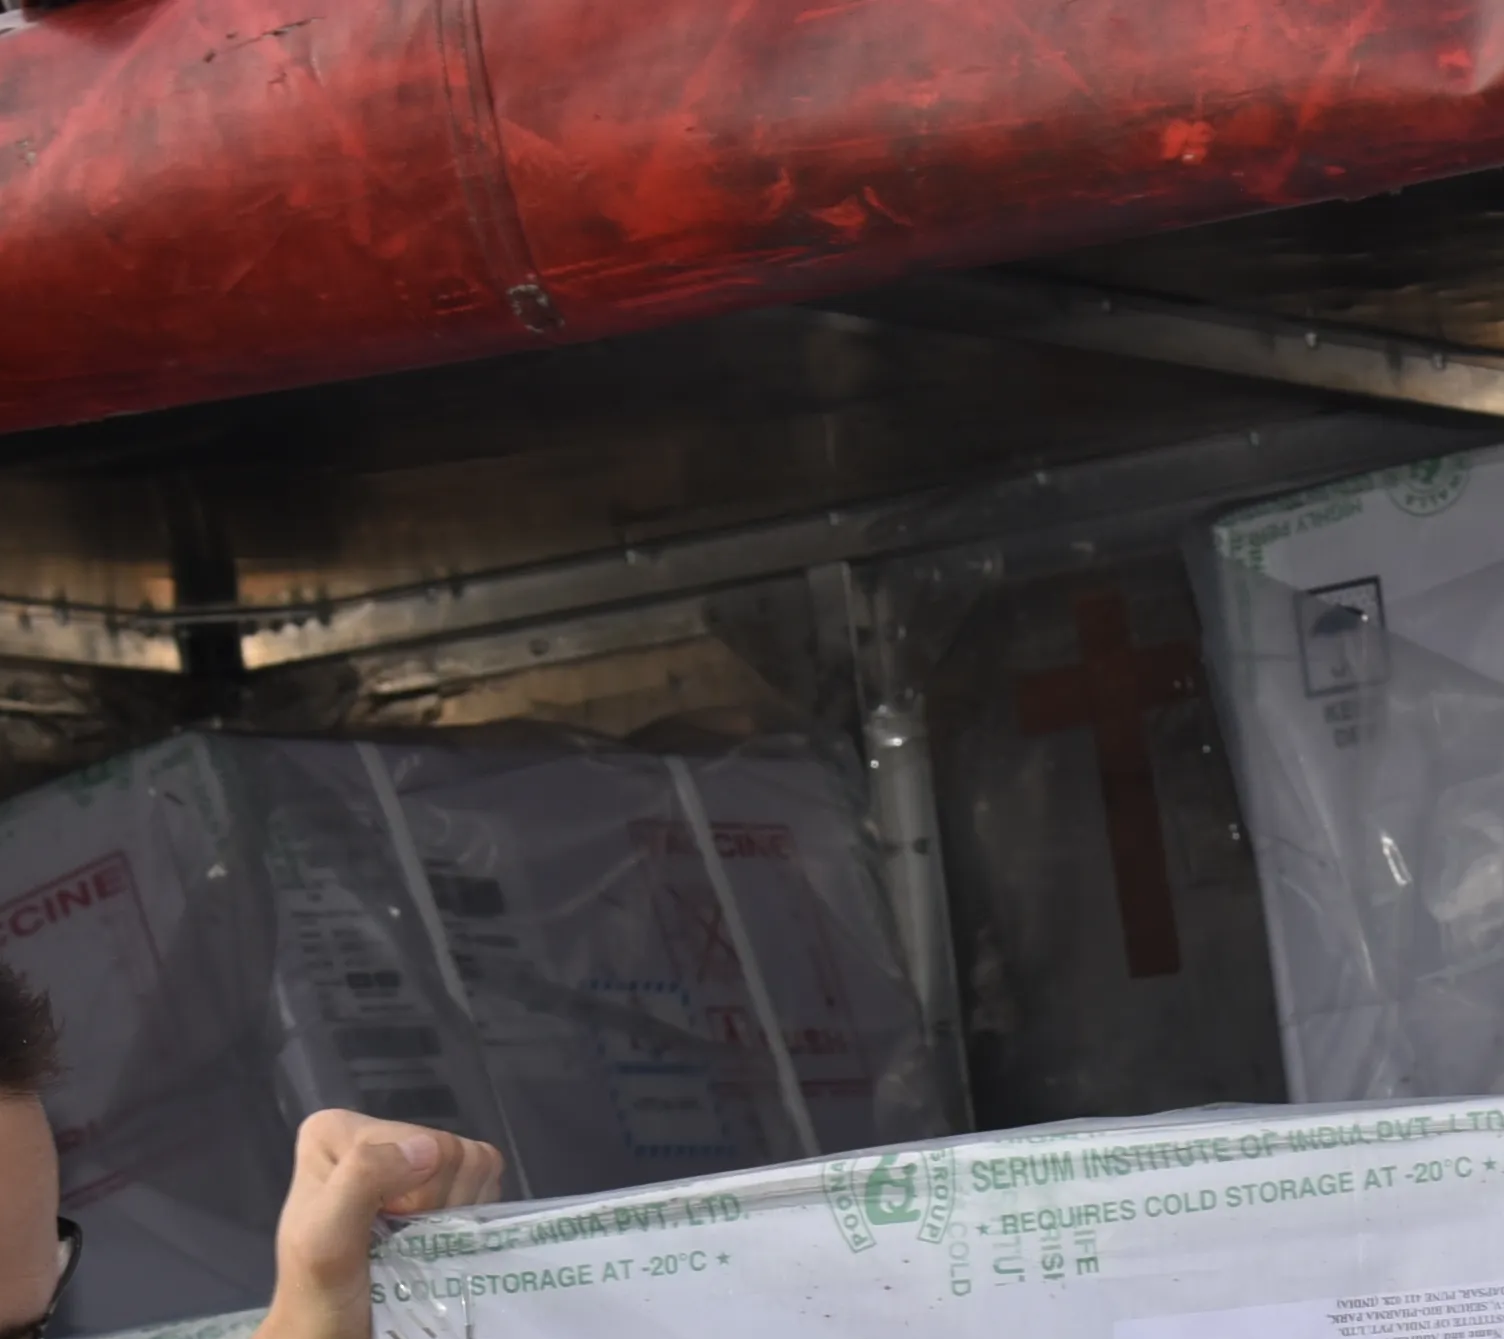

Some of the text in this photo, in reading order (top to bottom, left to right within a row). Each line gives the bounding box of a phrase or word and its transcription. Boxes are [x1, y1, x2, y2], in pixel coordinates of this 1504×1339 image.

[971, 1150, 1074, 1194] SERUM
[1083, 1135, 1230, 1181] INSTITUTE
[1240, 1131, 1276, 1162] OF
[1001, 1155, 1473, 1235] REQUIRES COLD STORAGE AT -20°C
[470, 1249, 707, 1297] STORAGE AT -20°C
